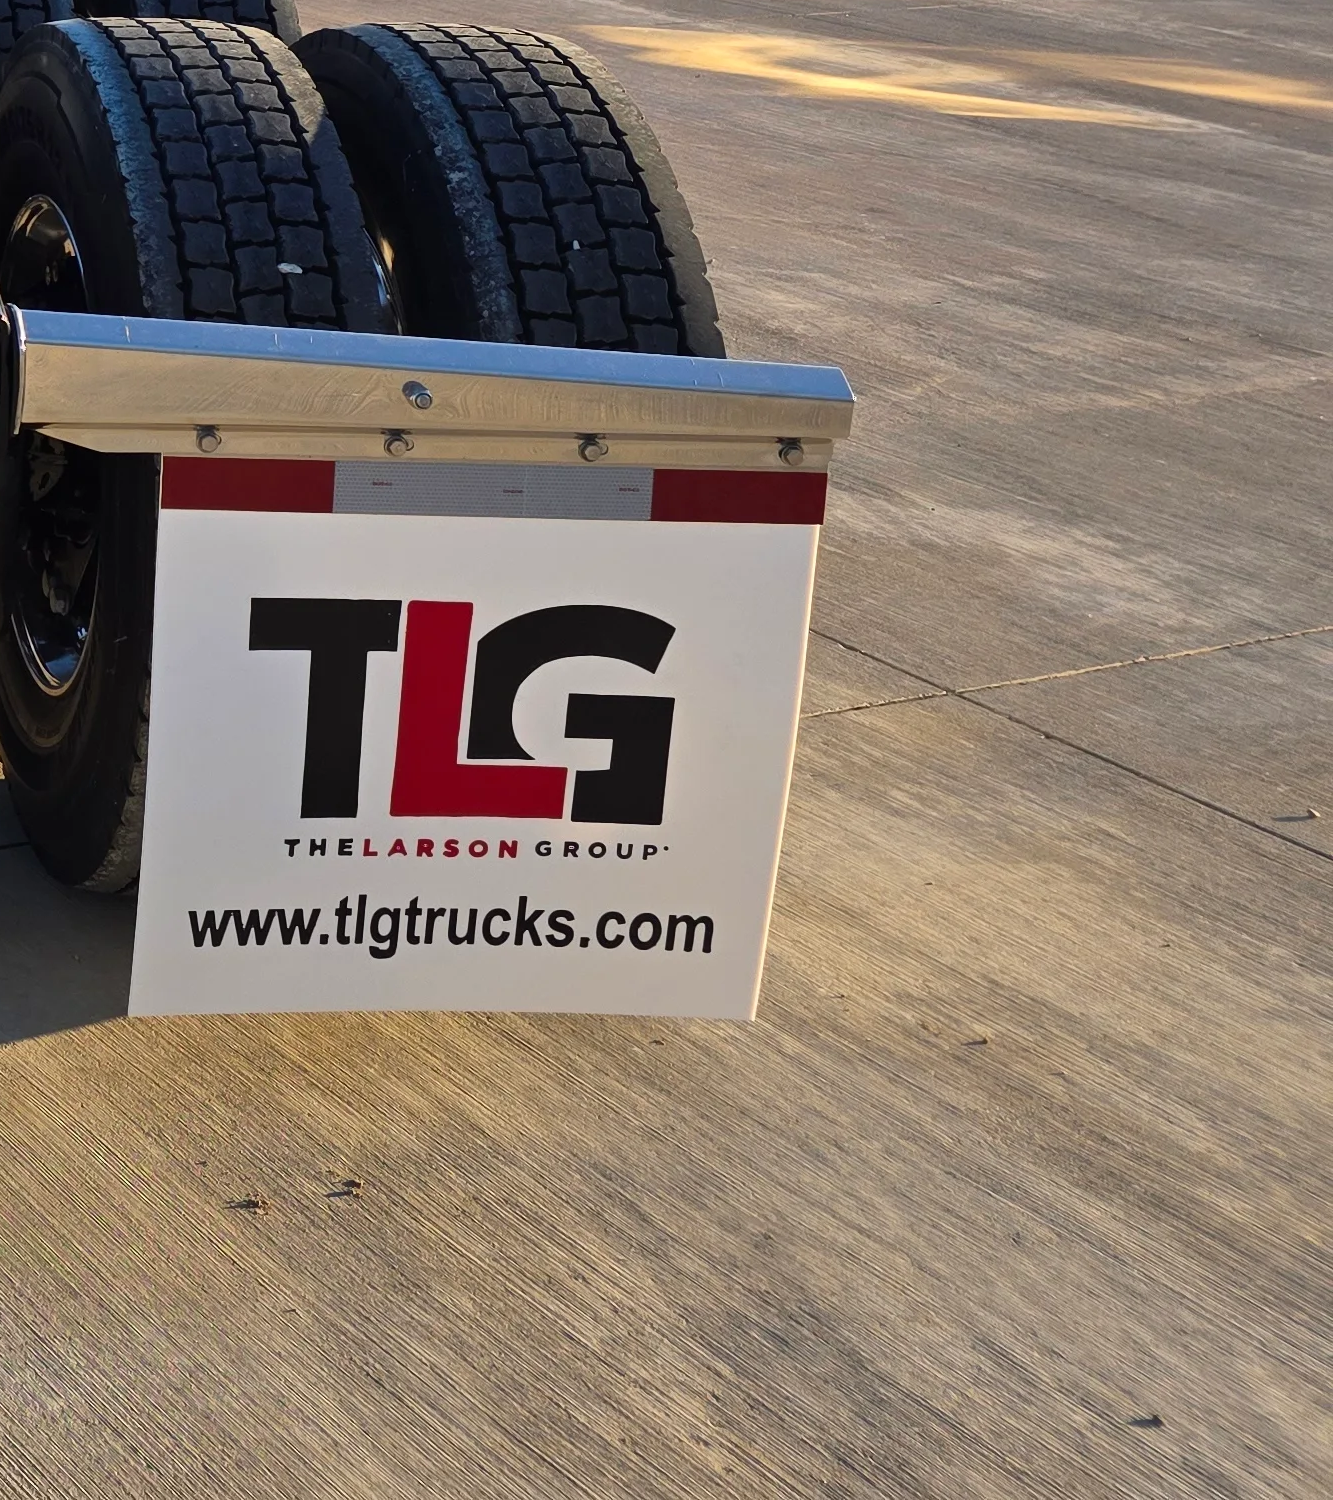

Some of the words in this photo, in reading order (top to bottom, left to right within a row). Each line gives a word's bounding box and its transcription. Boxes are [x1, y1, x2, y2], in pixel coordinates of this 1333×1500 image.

[248, 597, 676, 826] TLG
[534, 840, 658, 861] GROUP
[187, 894, 714, 960] www.tlgtrucks.com
